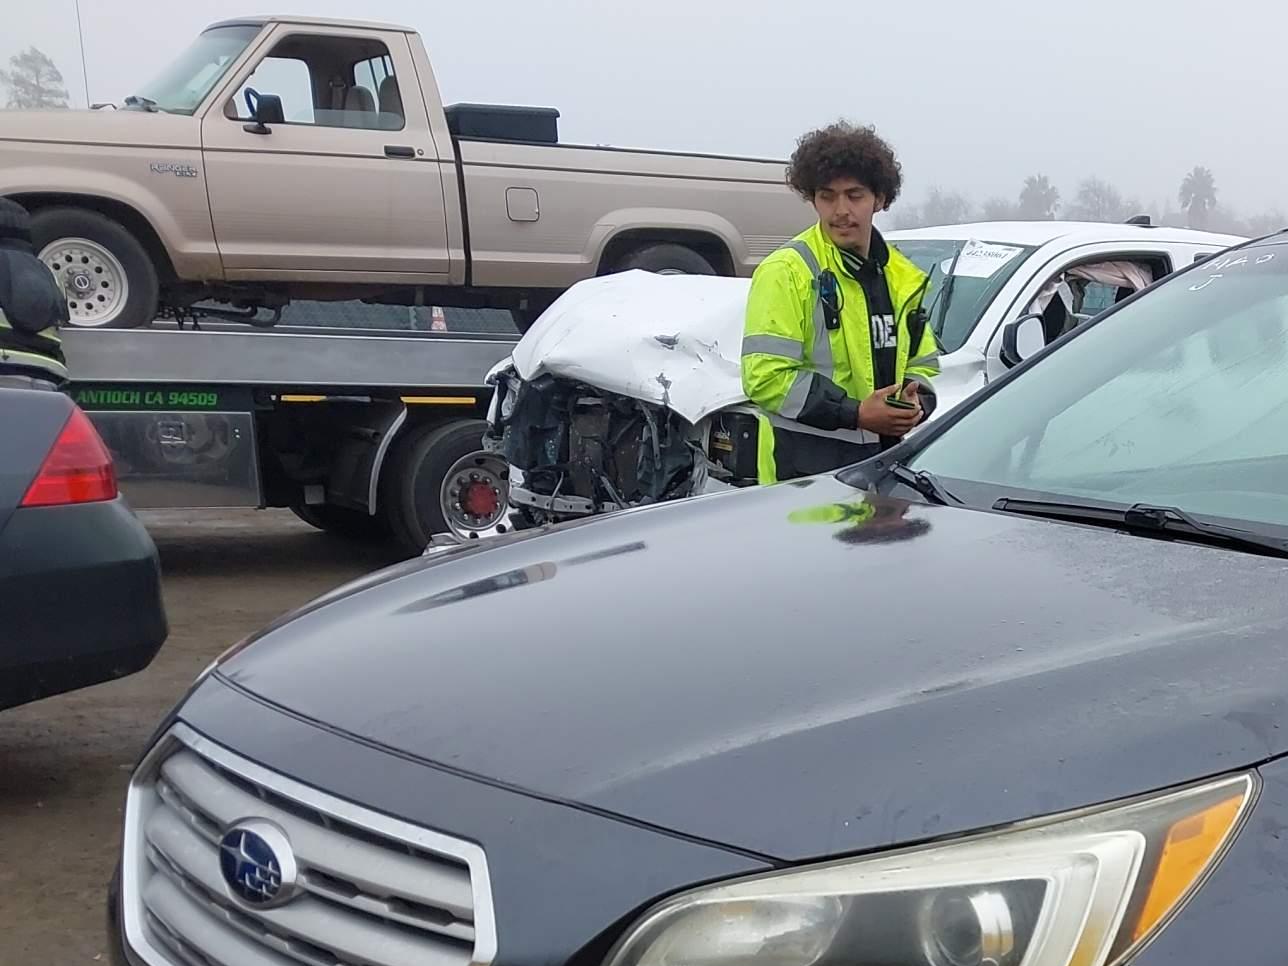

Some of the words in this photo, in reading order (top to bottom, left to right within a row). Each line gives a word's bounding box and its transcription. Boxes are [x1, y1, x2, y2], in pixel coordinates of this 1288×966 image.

[78, 391, 141, 405] ANTIOCH
[144, 391, 164, 405] CA
[168, 392, 218, 406] 94509
